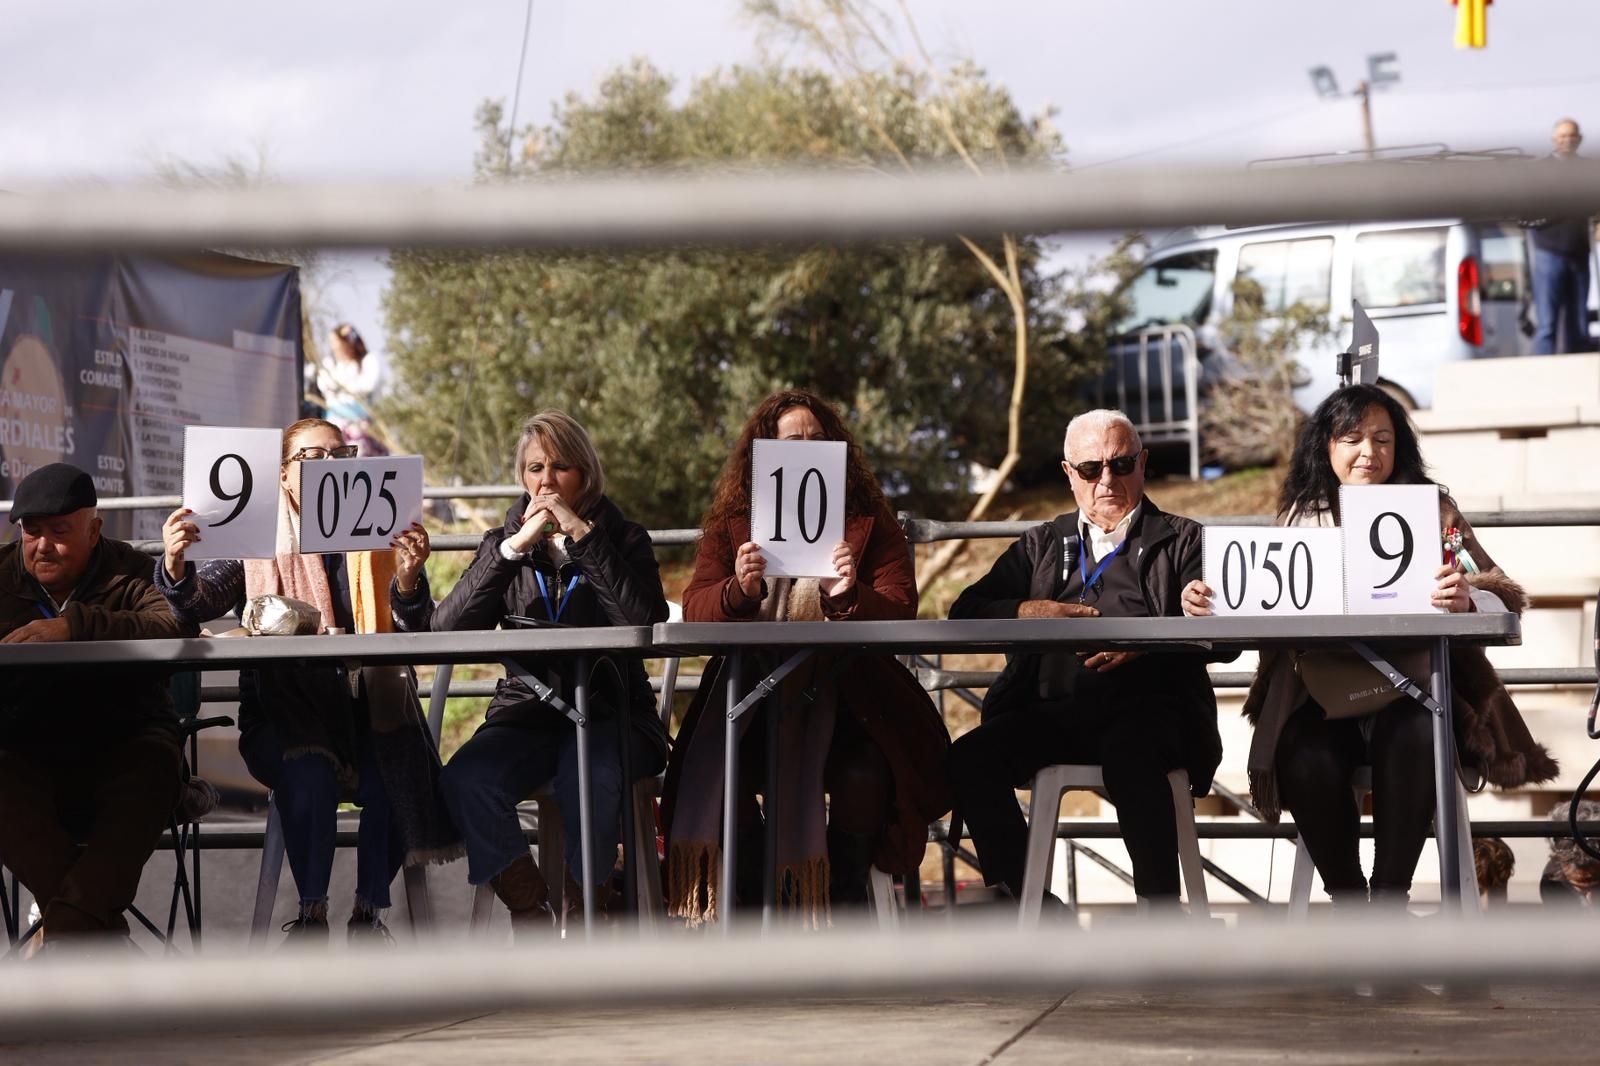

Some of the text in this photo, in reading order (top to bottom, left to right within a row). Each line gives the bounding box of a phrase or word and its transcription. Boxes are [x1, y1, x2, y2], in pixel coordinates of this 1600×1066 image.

[207, 453, 253, 529] 9
[316, 470, 398, 539] 0'25
[769, 466, 828, 544] 10
[1222, 540, 1314, 610] 0'50
[1369, 511, 1414, 589] 9
